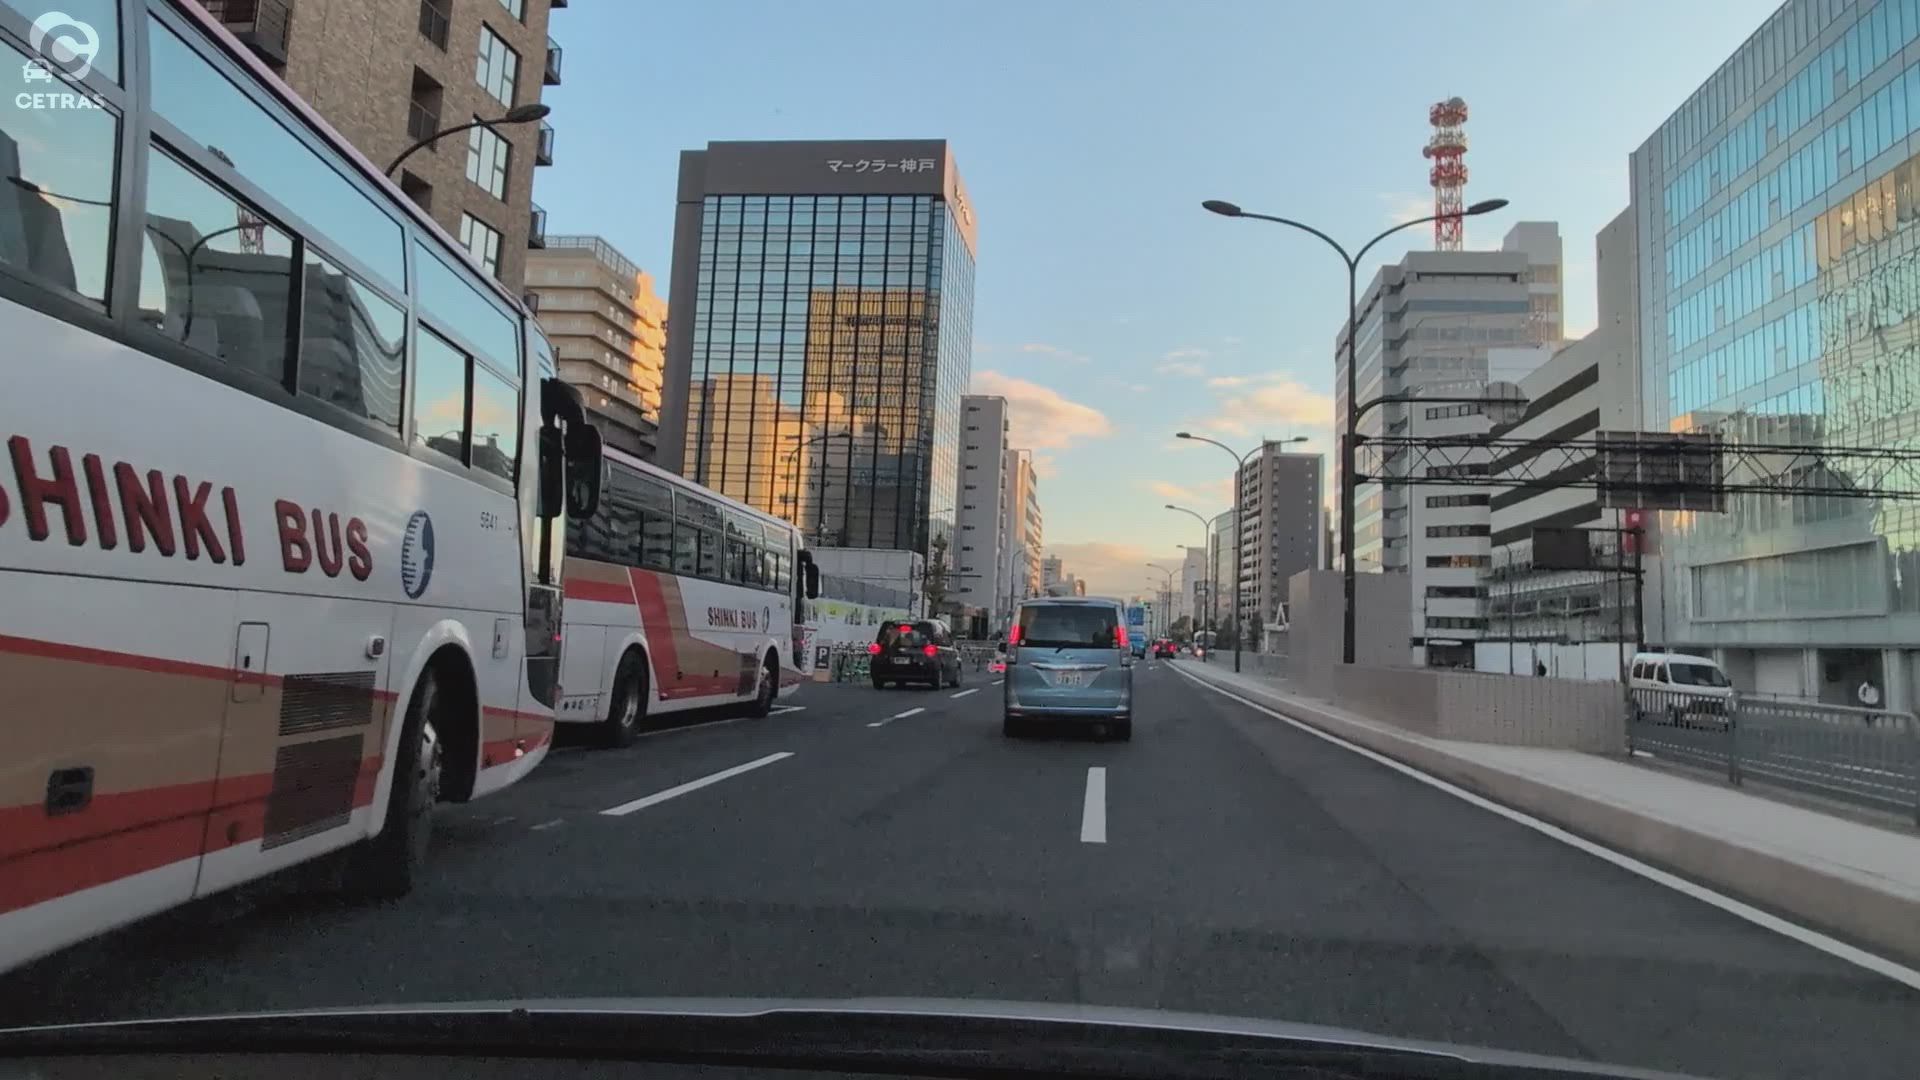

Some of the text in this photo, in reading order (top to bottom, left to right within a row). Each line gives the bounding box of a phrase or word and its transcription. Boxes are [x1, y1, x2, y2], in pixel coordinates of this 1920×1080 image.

[827, 158, 936, 173] マークラー神戸
[0, 435, 373, 582] HINKI BUS
[707, 606, 758, 629] SHINKI BUS
[819, 647, 828, 660] P
